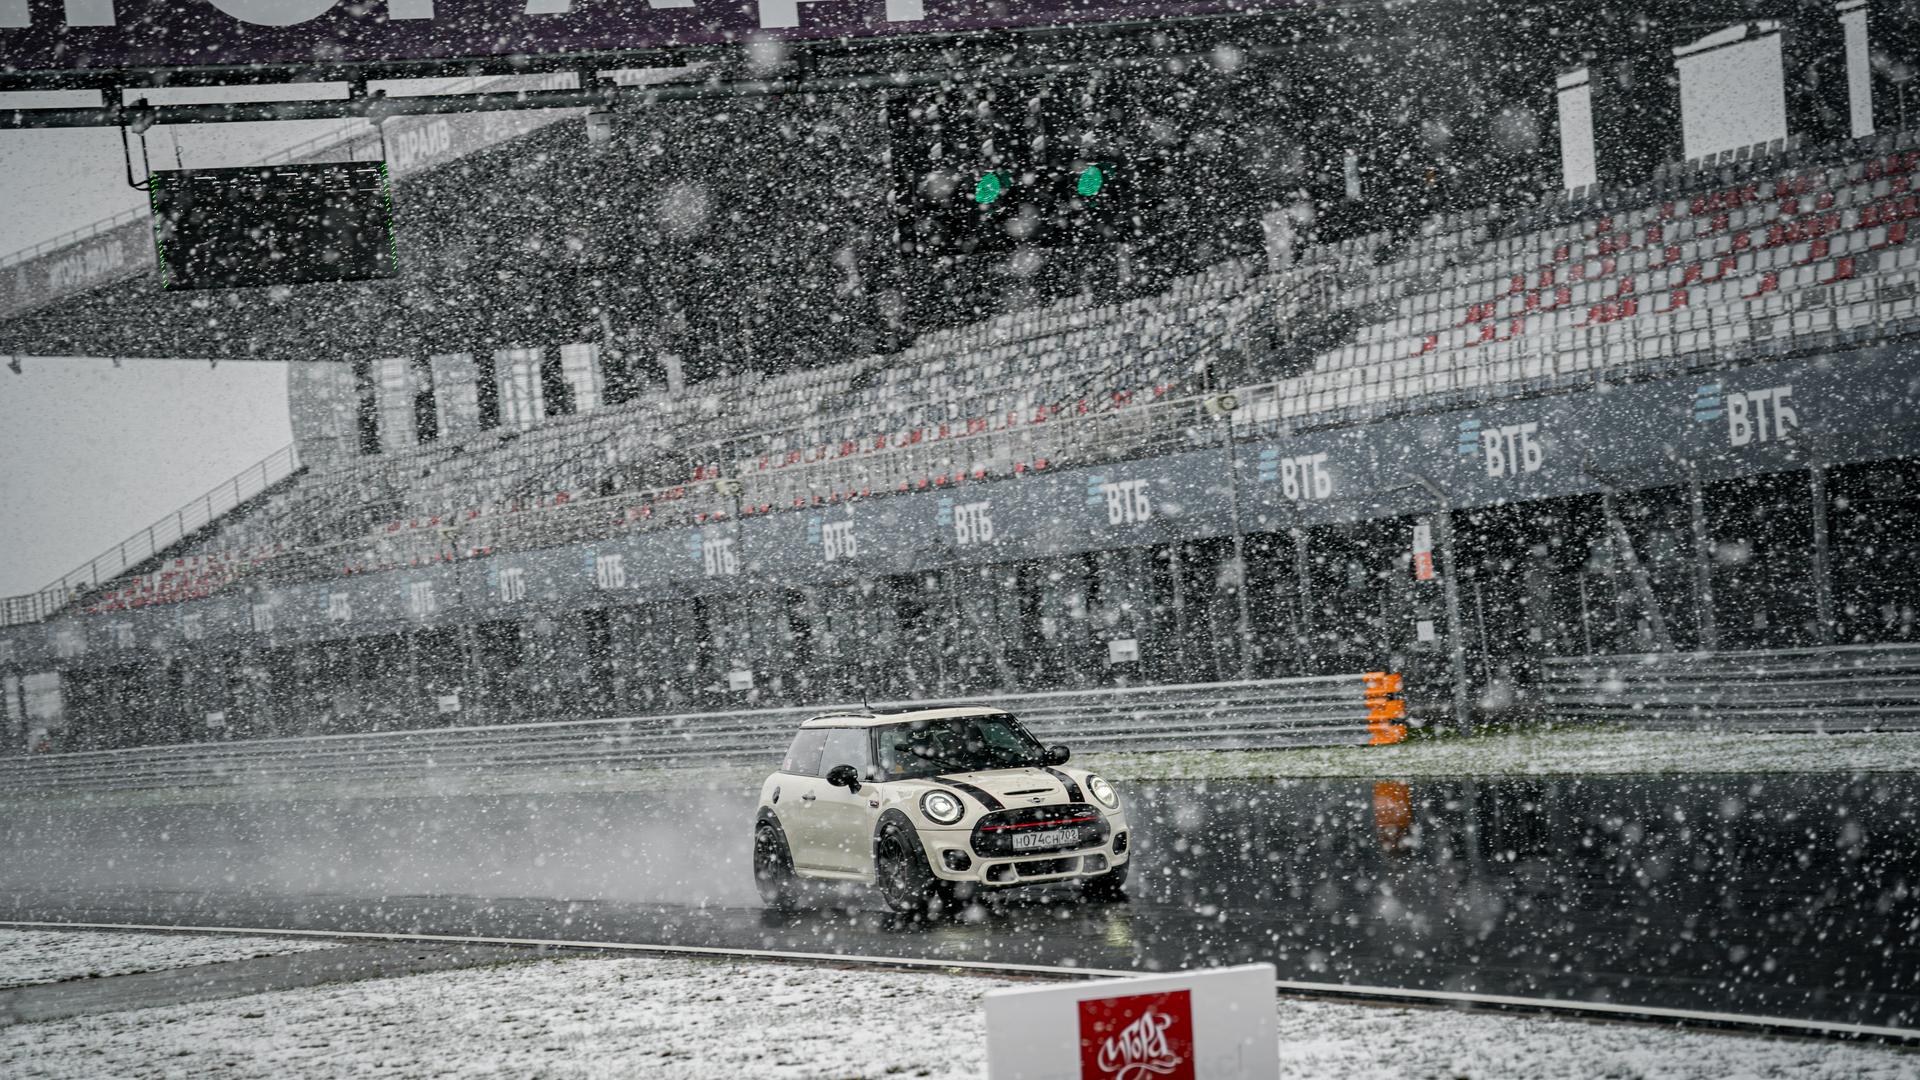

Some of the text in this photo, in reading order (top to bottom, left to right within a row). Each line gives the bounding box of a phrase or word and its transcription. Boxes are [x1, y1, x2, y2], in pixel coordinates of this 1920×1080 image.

[1727, 385, 1798, 447] ВТБ
[1482, 422, 1542, 478] ВТБ
[1281, 452, 1332, 500] ВТБ
[954, 500, 993, 544] ВТБ
[1103, 479, 1150, 525] ВТБ
[703, 537, 738, 577] ВТБ
[823, 520, 857, 561] ВТБ
[597, 554, 625, 589] ВТБ
